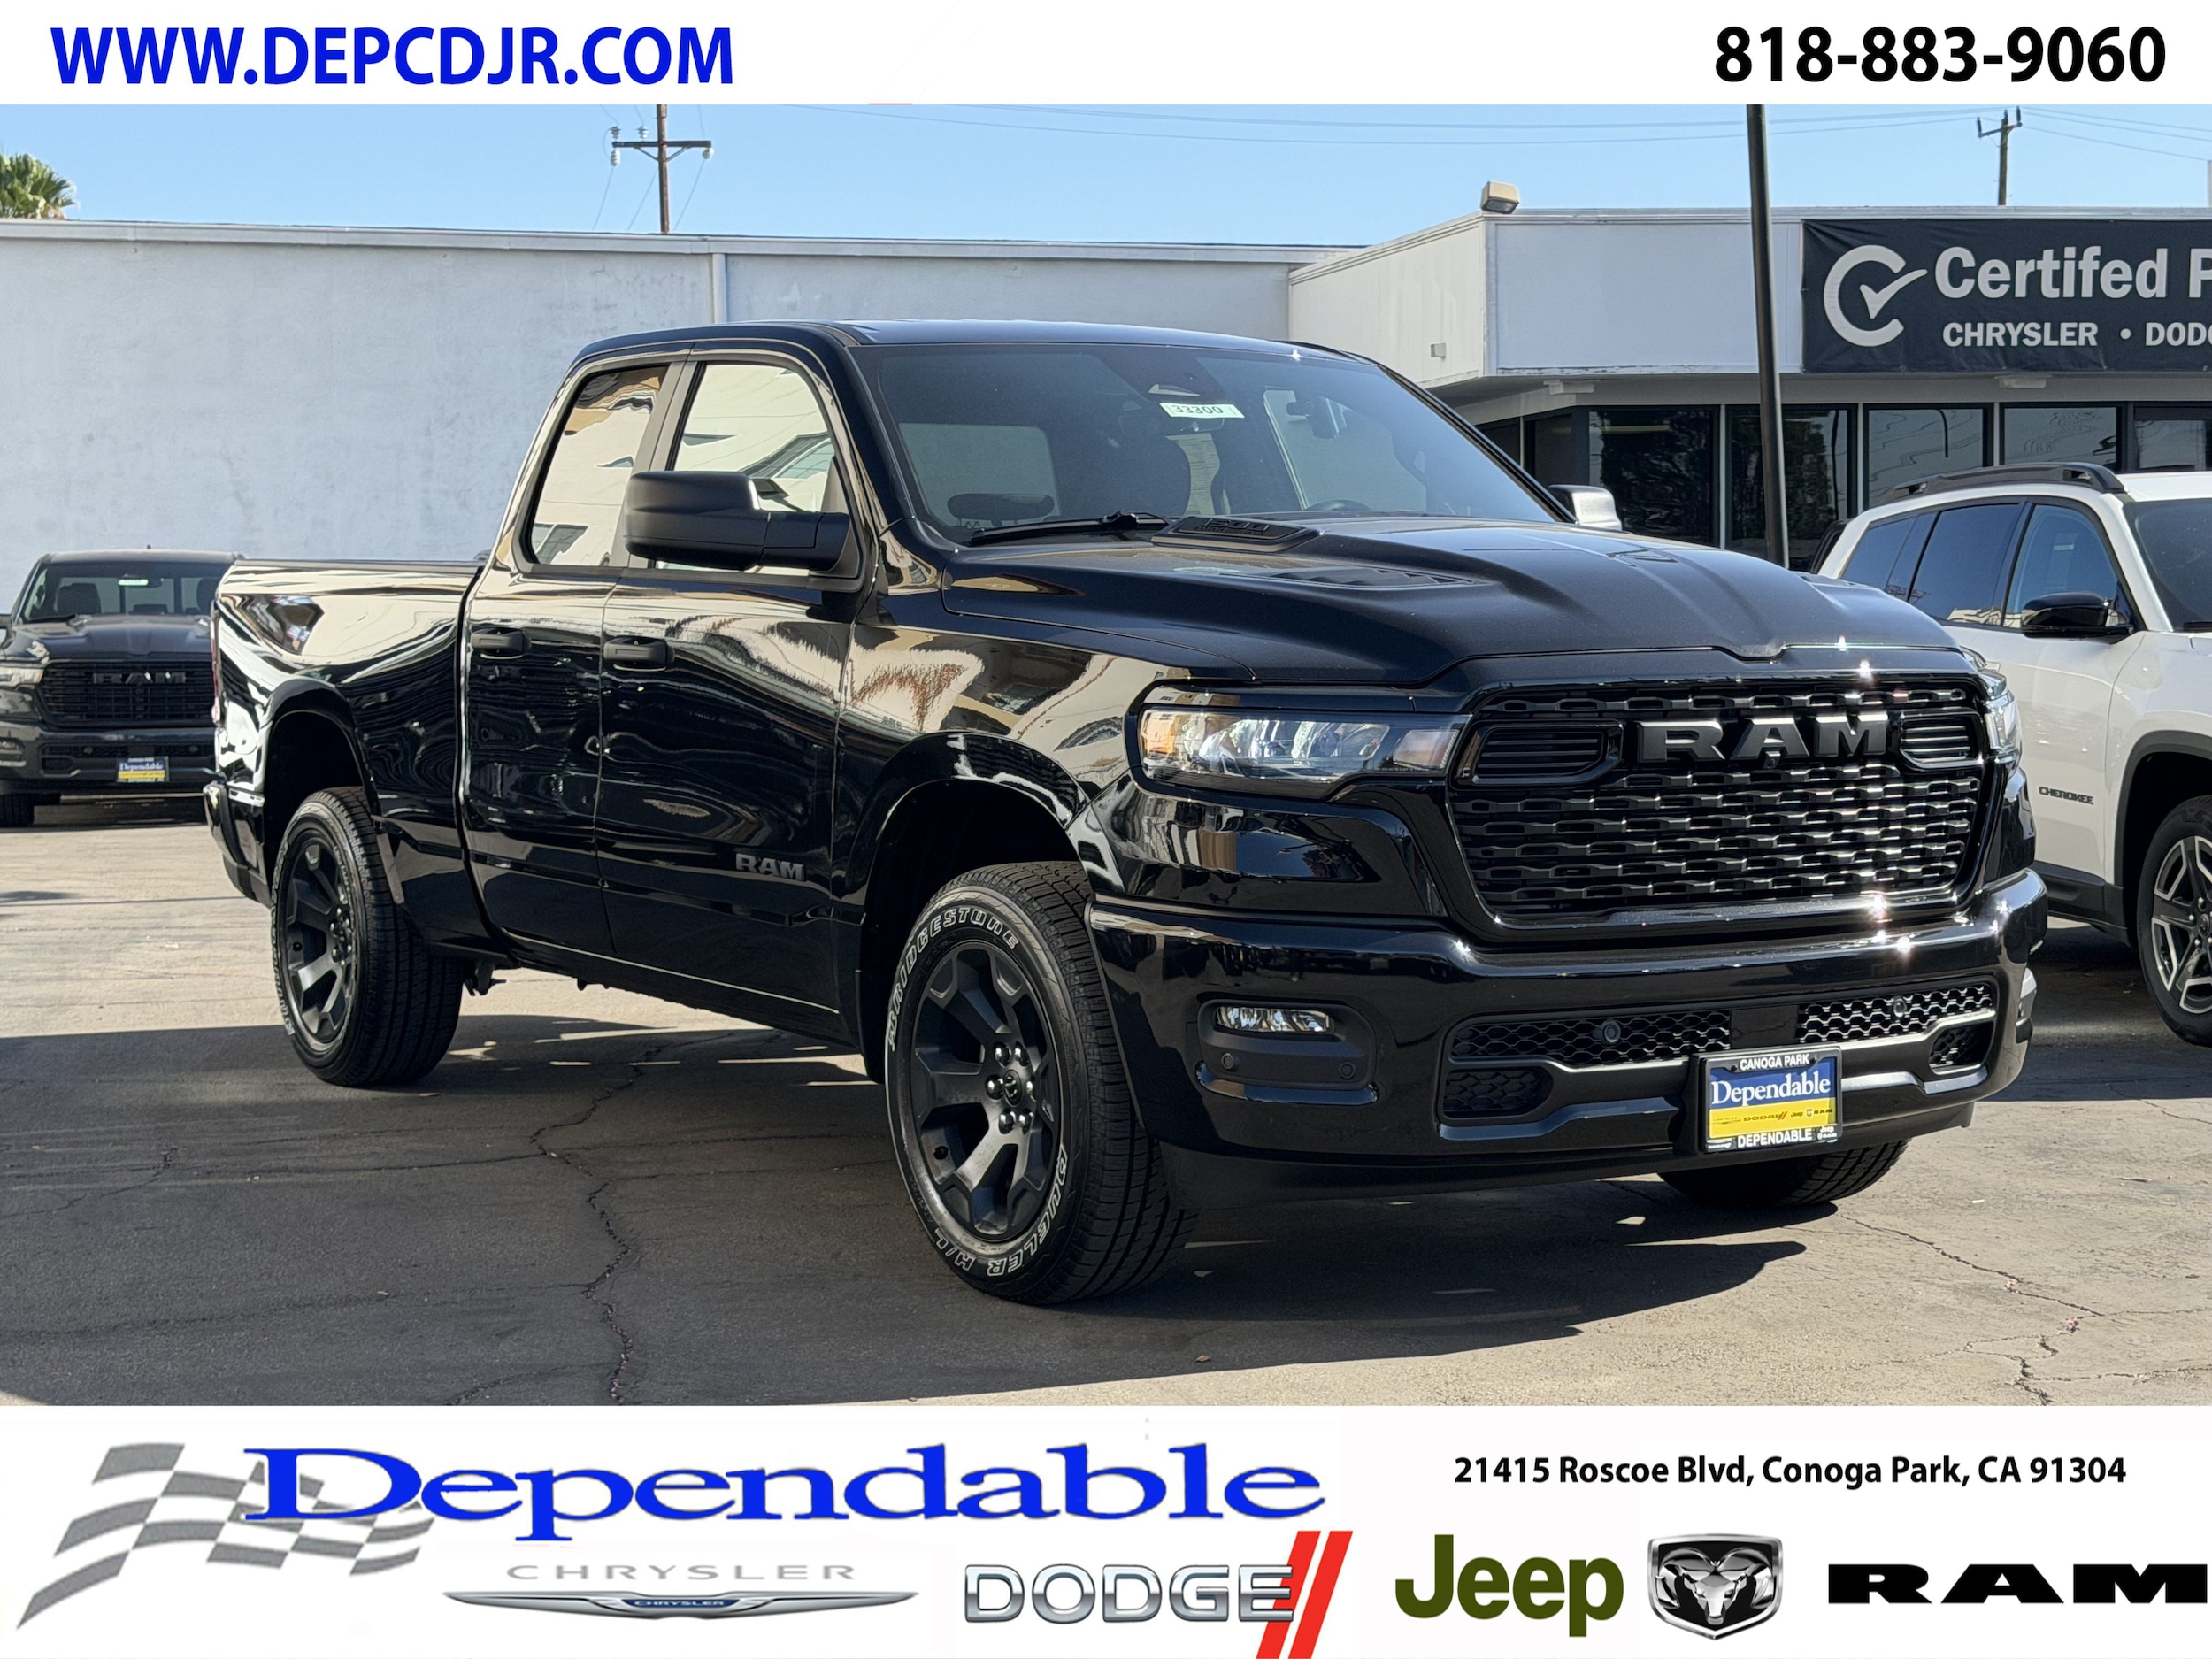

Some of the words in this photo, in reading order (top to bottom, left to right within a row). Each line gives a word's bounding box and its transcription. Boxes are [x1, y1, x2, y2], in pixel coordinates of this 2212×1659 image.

[1942, 322, 2098, 347] CHRYSLER
[1171, 404, 1225, 414] 33300
[93, 672, 186, 684] RAM
[1637, 710, 1889, 763] RAM
[2039, 786, 2094, 805] CHEROKEE
[735, 853, 805, 882] RAM
[887, 907, 1019, 1052] BRIDGESTONE
[1740, 1056, 1782, 1070] CANOGA
[1785, 1054, 1809, 1066] PARK
[1711, 1071, 1831, 1106] Dependable
[1738, 1128, 1812, 1148] DEPENDABLE
[986, 1143, 1068, 1277] DUELER
[934, 1227, 977, 1271] H/L
